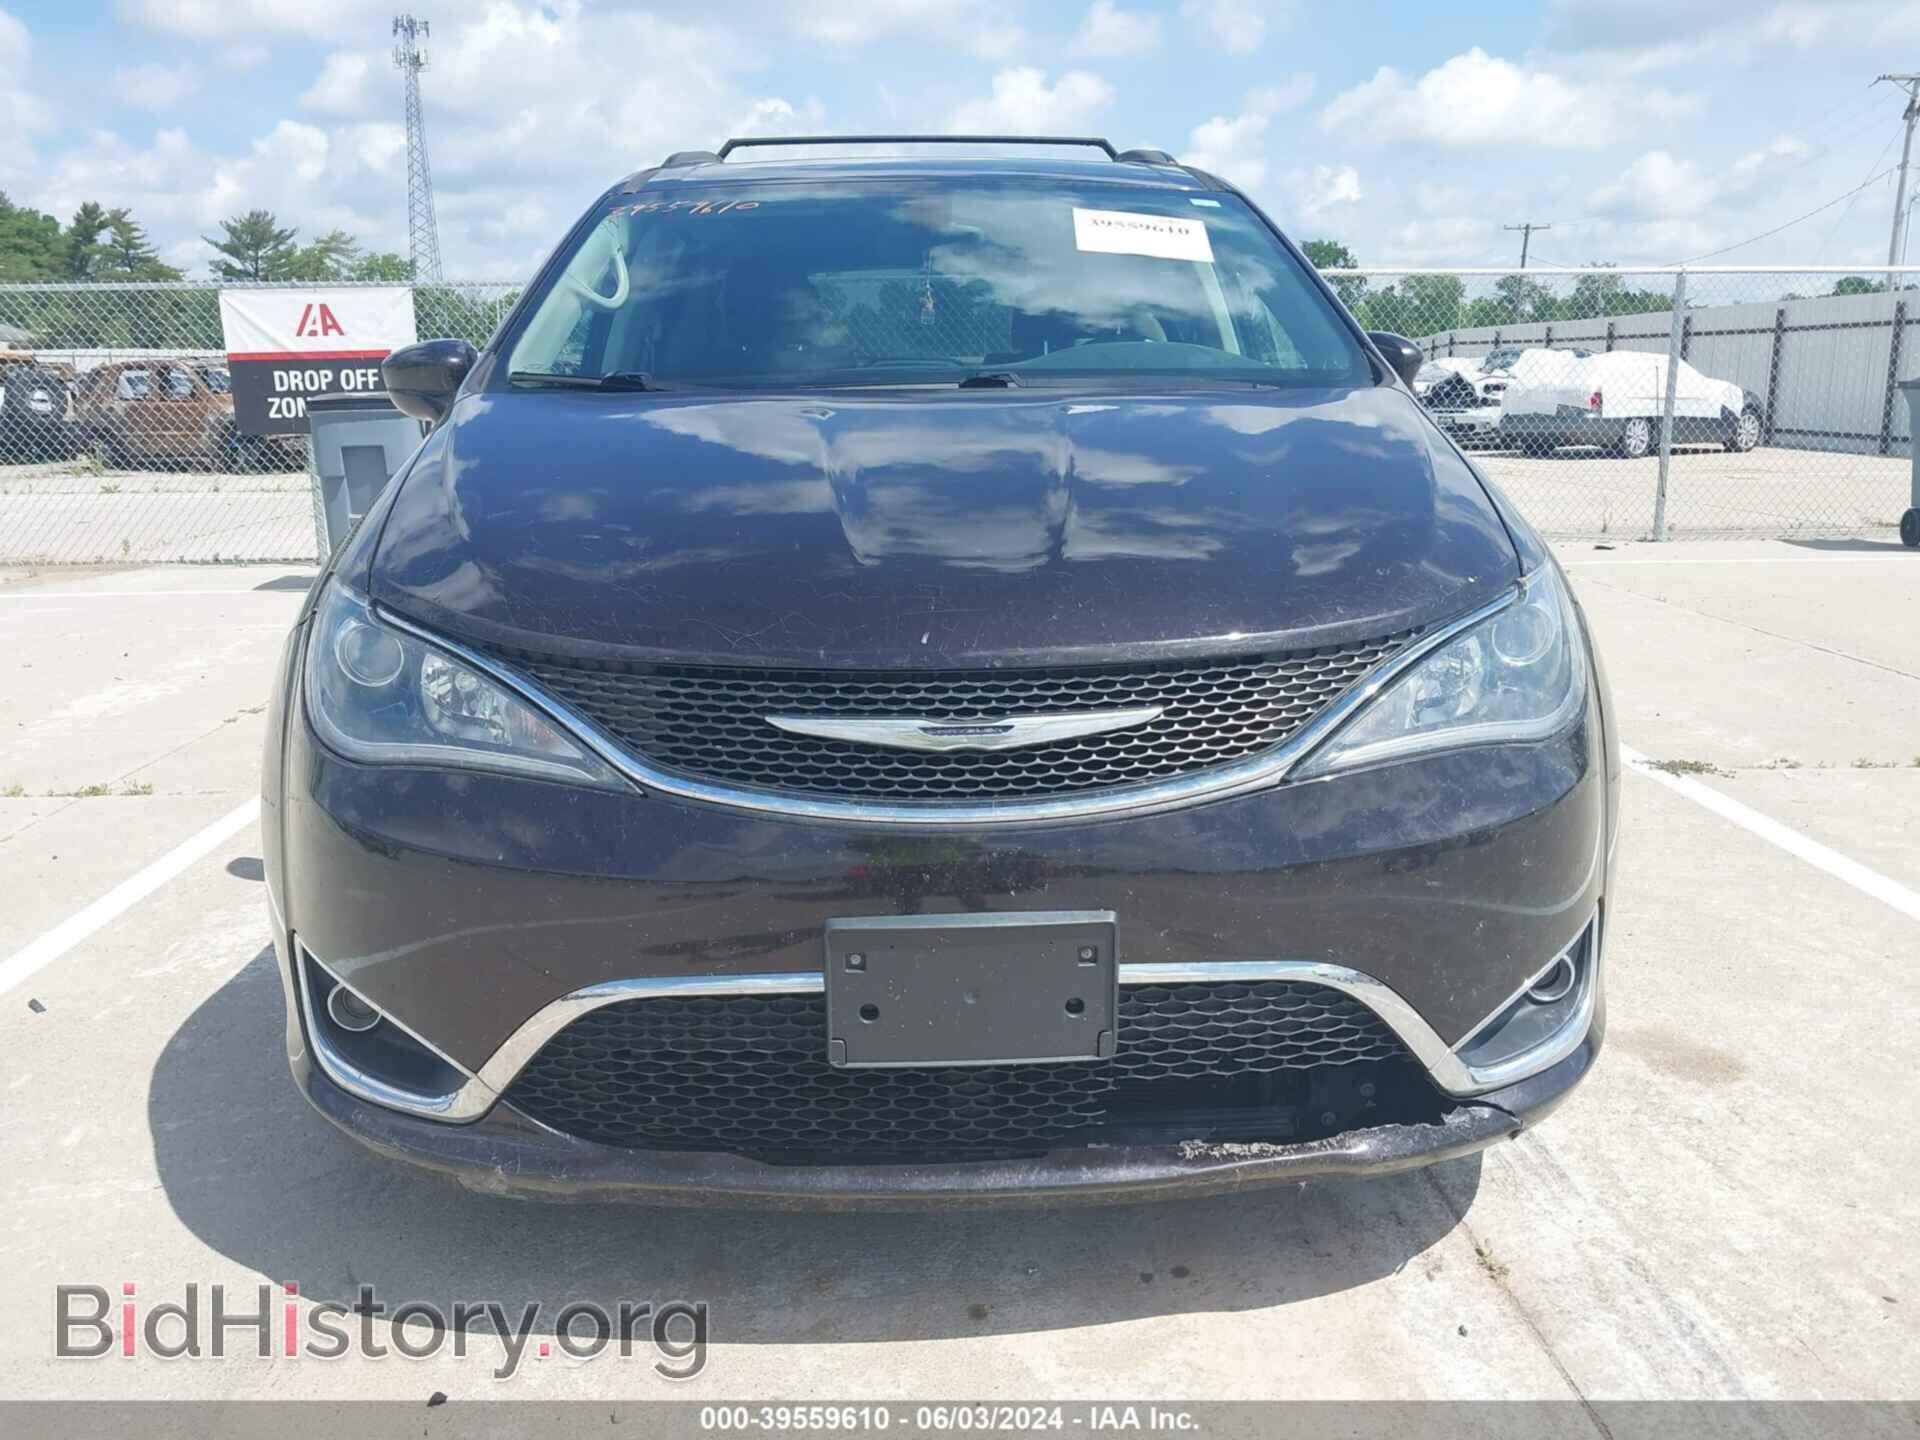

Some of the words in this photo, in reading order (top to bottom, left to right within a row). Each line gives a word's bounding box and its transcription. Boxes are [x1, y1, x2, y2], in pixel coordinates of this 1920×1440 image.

[273, 369, 333, 392] DROP
[340, 368, 379, 390] OFF
[267, 396, 311, 419] ZON
